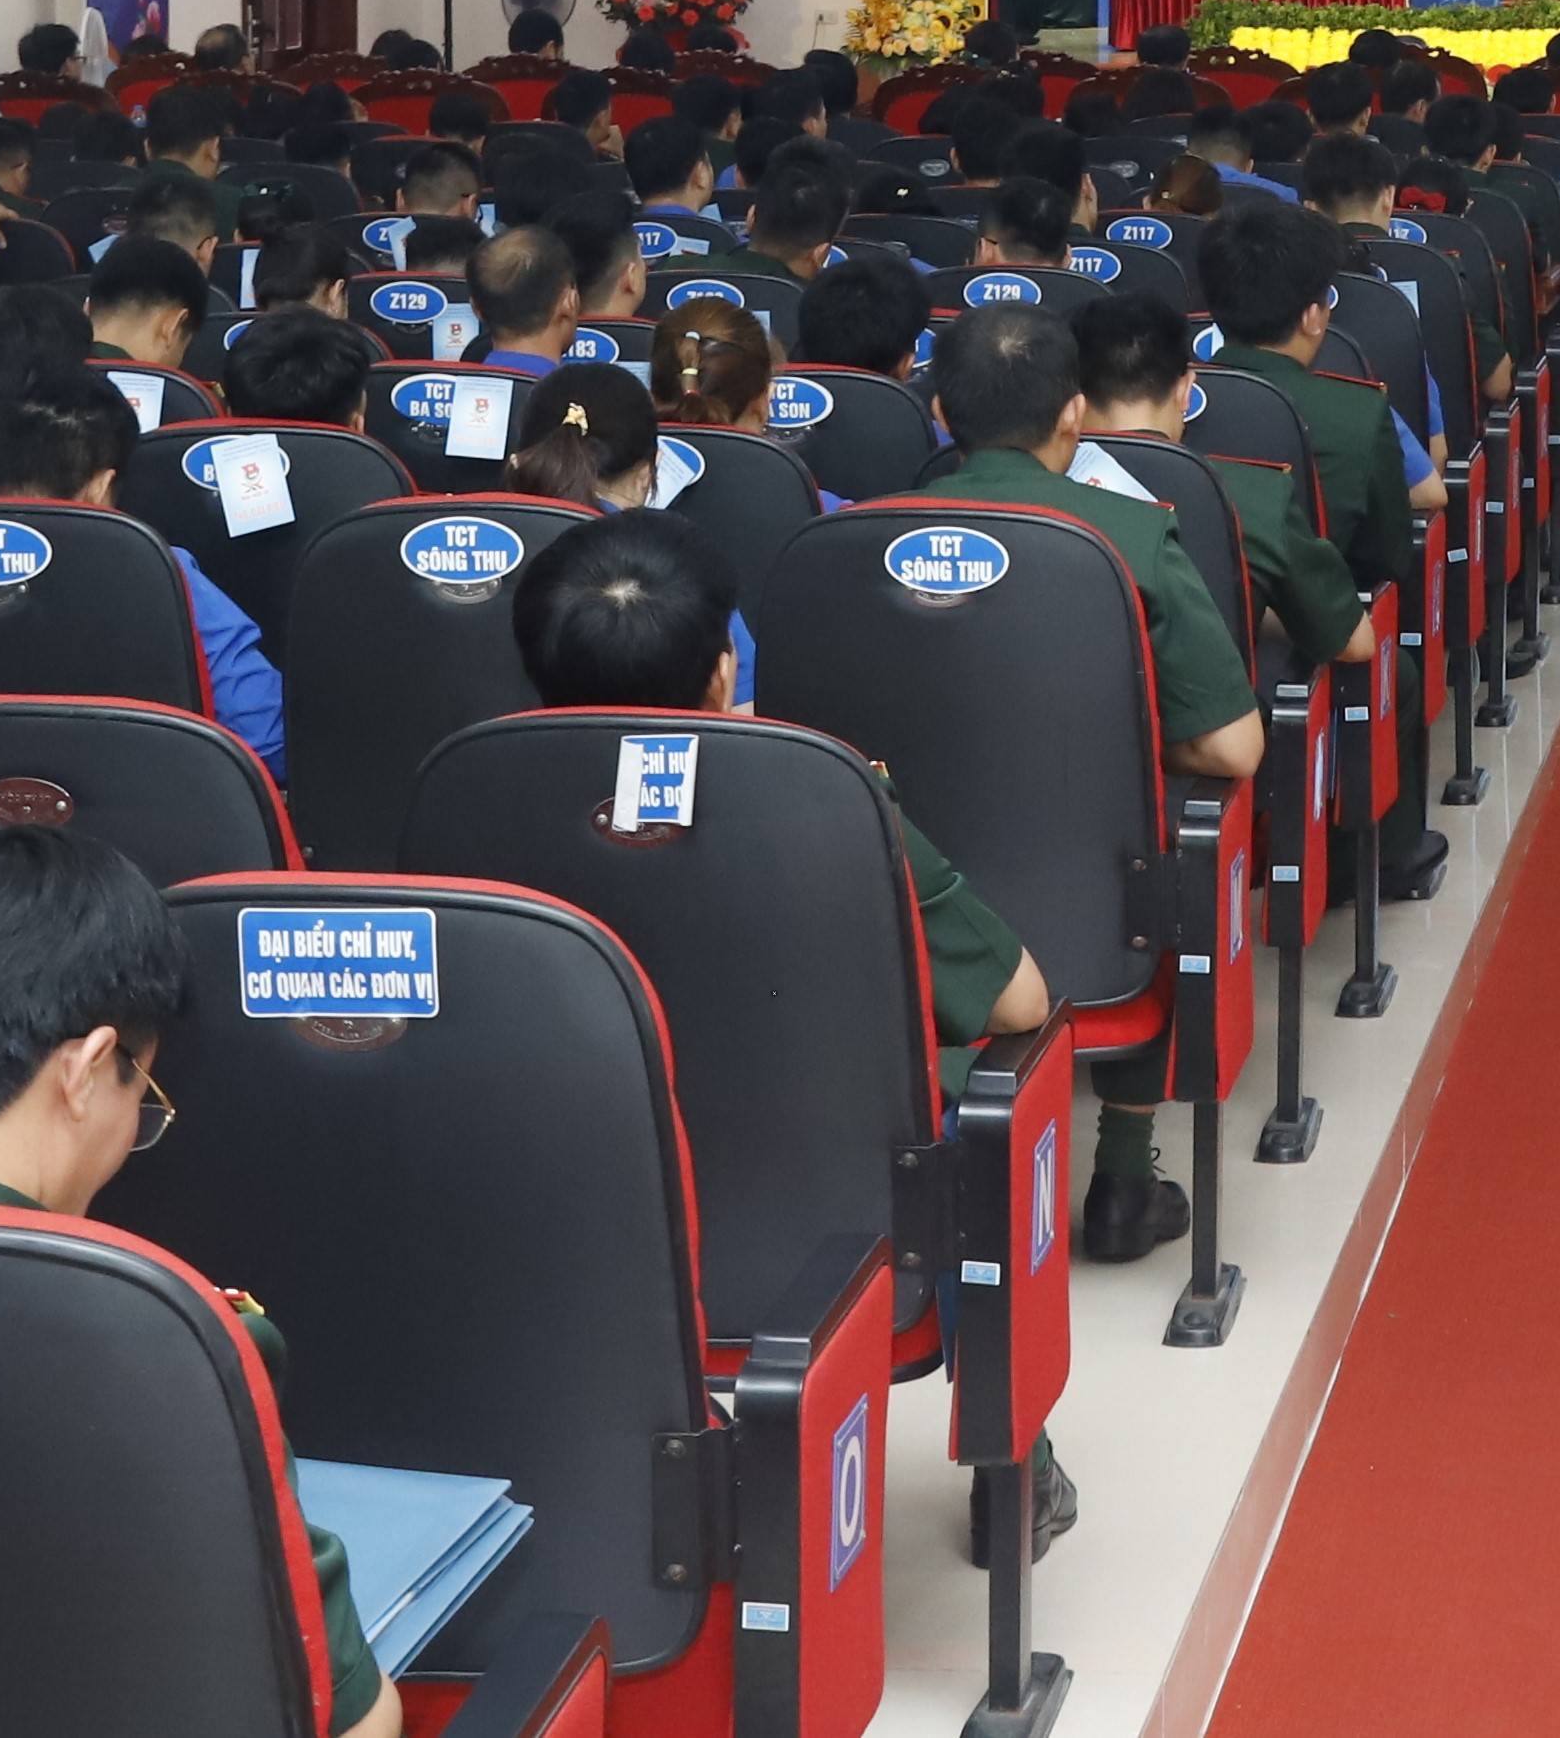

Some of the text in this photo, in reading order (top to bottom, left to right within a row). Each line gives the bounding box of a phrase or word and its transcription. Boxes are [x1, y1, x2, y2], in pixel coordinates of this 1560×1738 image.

[1123, 225, 1155, 242] Z117
[984, 283, 1021, 301] Z129
[0, 553, 35, 575] THU
